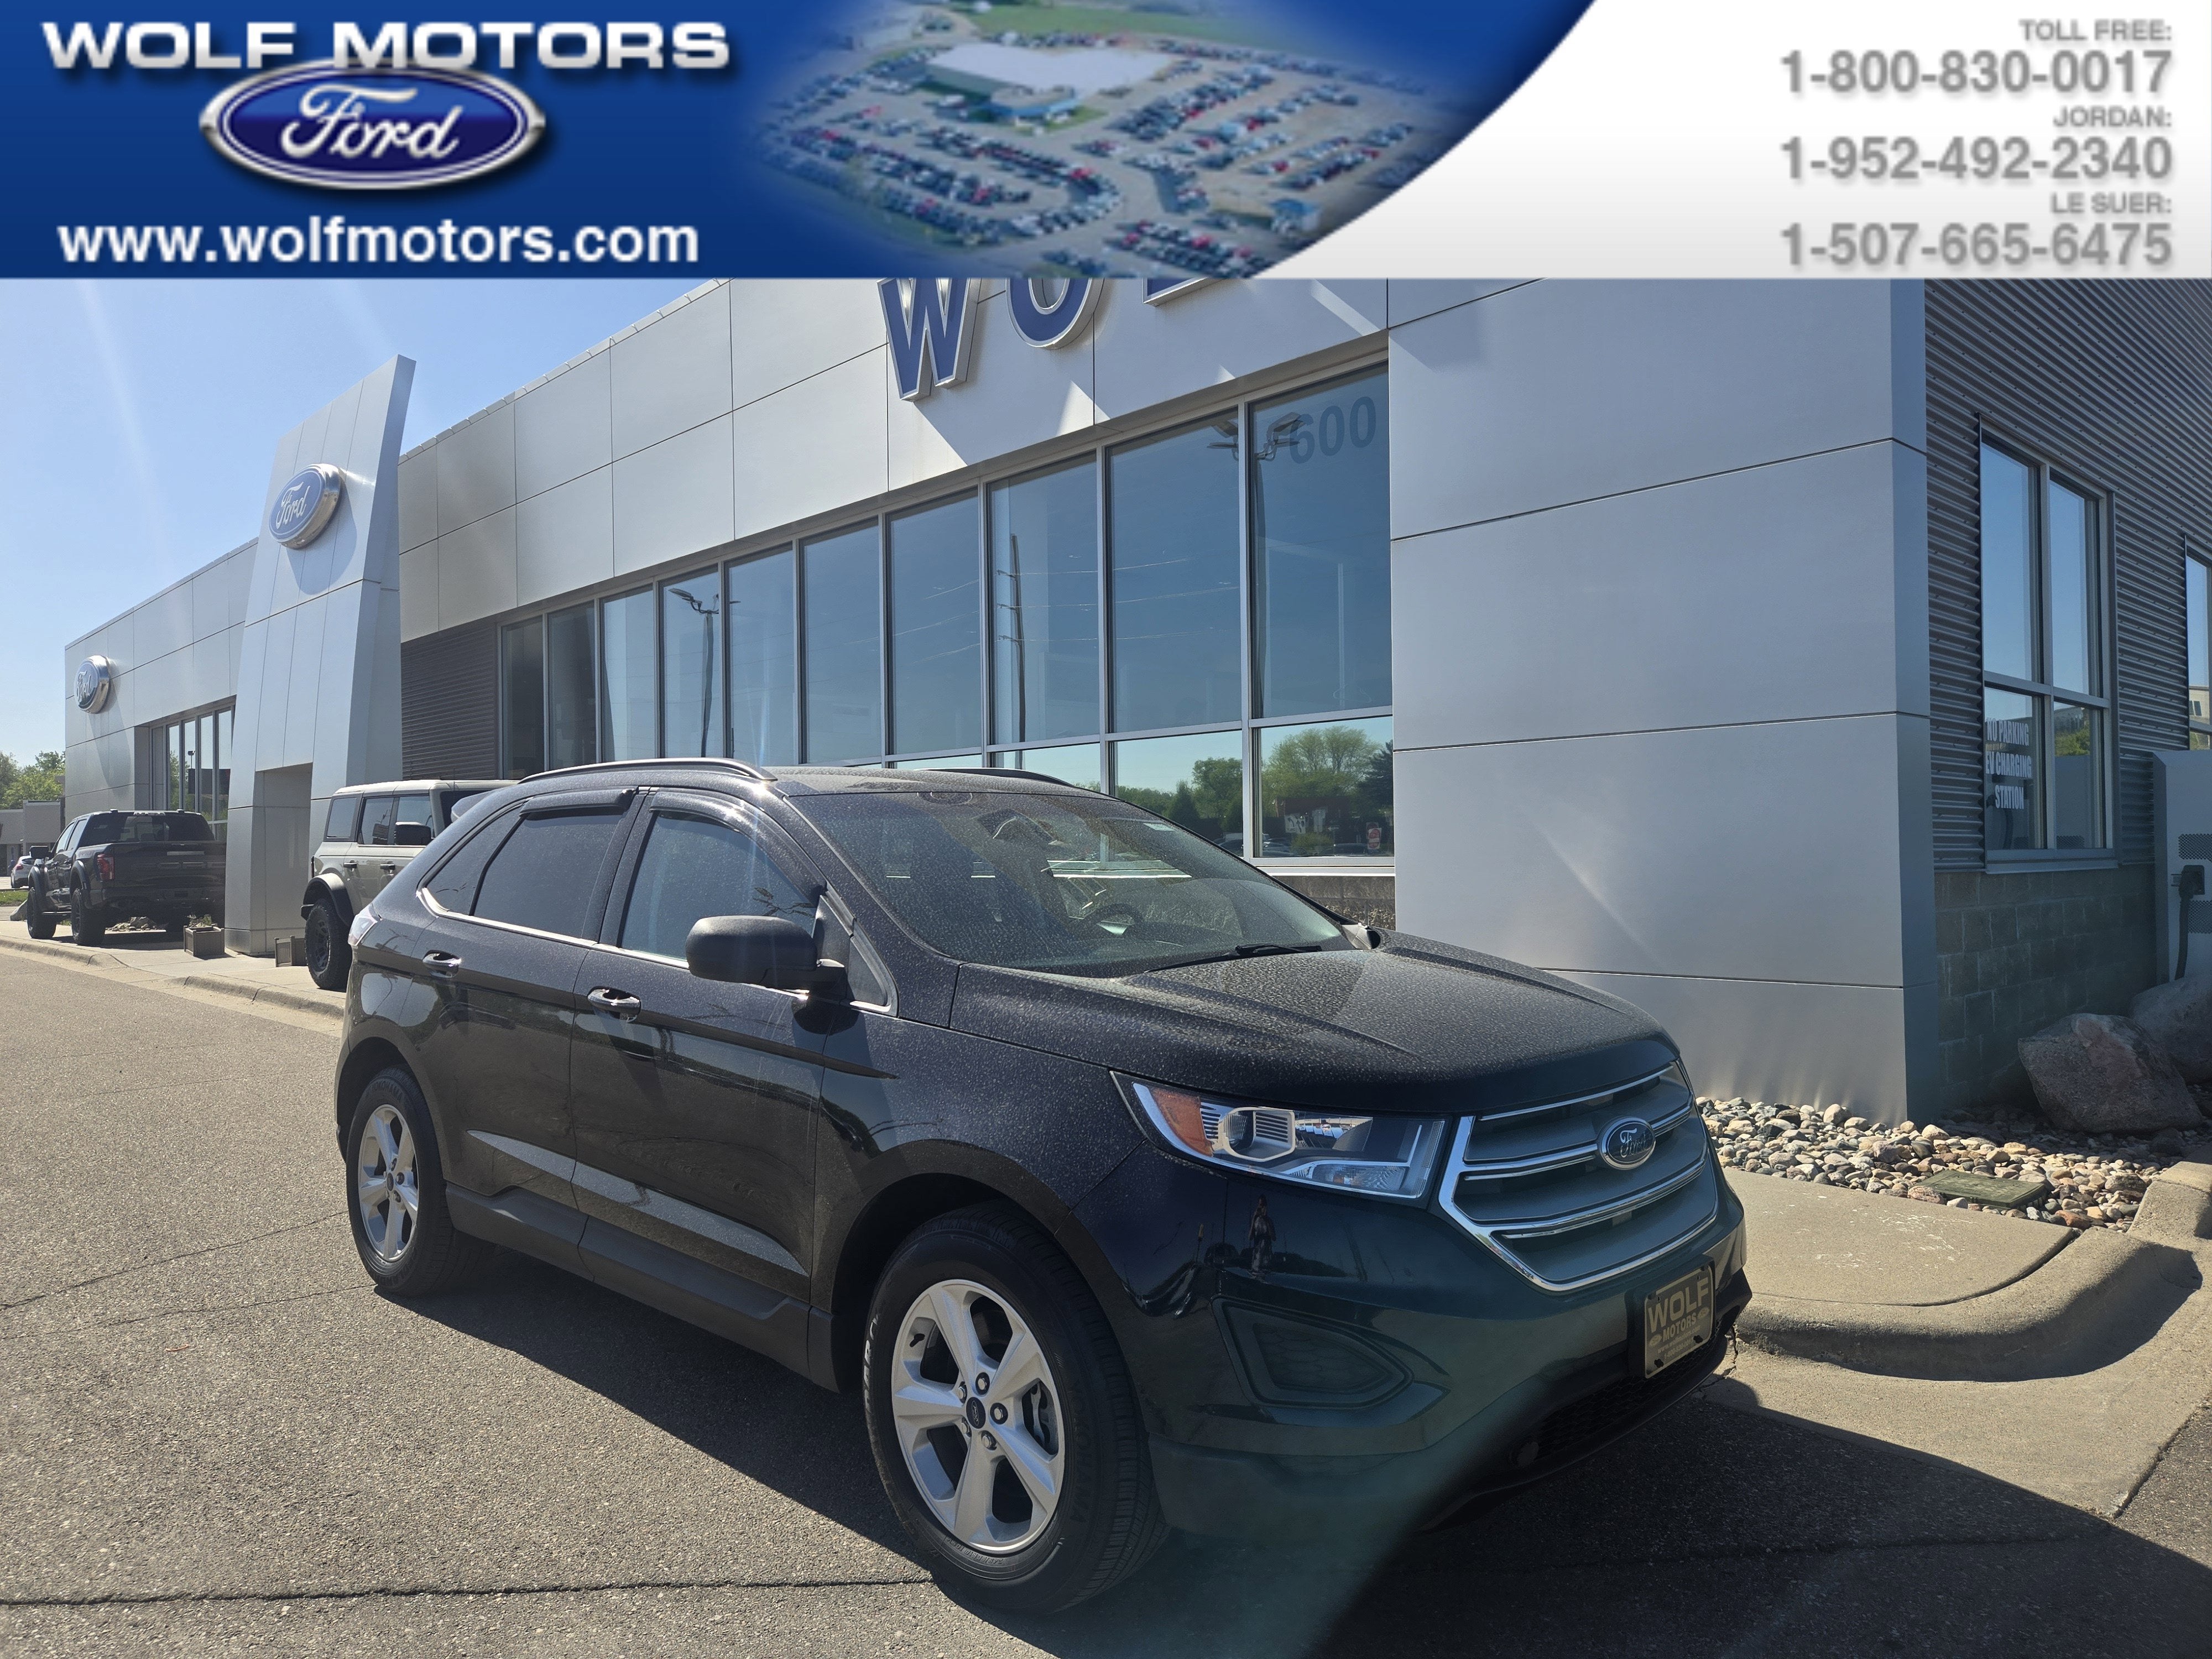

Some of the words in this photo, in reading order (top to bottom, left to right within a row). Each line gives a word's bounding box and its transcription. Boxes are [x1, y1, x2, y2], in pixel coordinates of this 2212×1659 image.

[1290, 397, 1376, 464] 600
[275, 481, 311, 529] Ford
[76, 670, 91, 703] Ford
[1987, 718, 1997, 742] NO
[1999, 719, 2030, 746] PARKING
[1985, 751, 1995, 775] EV
[1996, 752, 2032, 778] CHARGING
[1995, 785, 2025, 810] STATION
[1648, 1277, 1709, 1333] WOLF
[1662, 1312, 1697, 1343] MOTORS
